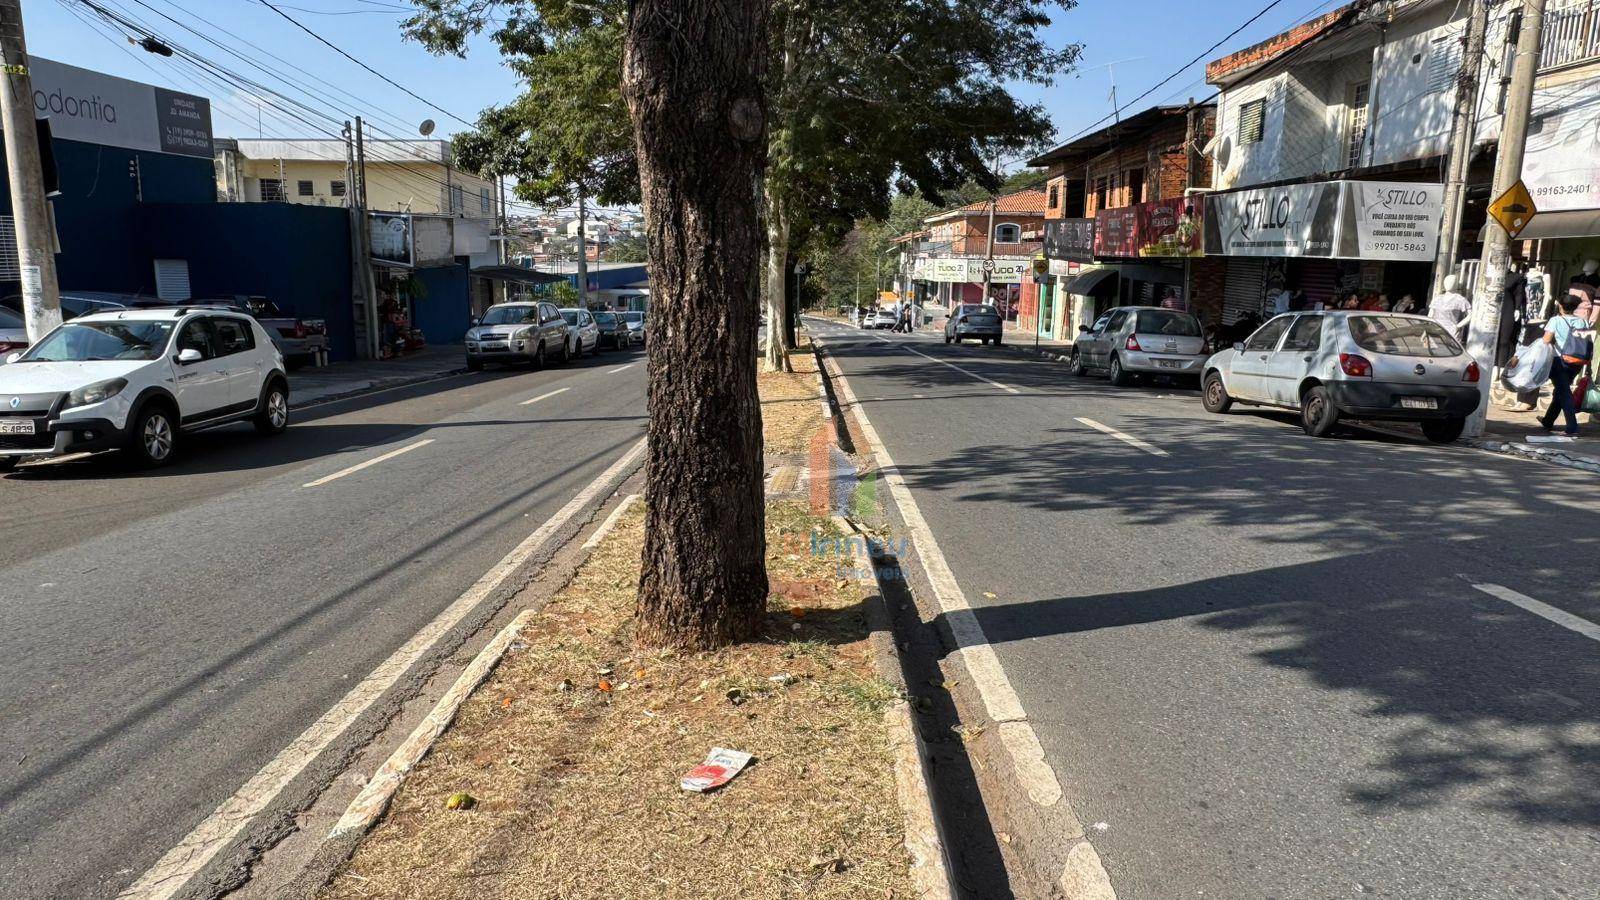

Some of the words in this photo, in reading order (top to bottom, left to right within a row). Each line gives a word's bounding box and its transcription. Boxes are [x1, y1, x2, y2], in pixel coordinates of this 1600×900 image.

[33, 88, 117, 124] odontia
[1537, 184, 1591, 196] 99163-2401
[1386, 189, 1428, 206] STILLO
[1241, 195, 1290, 231] STILLO
[1286, 220, 1301, 234] FIT
[1384, 221, 1407, 229] ENQUANTO
[1374, 242, 1426, 252] 99201-5843
[1015, 265, 1024, 273] 20
